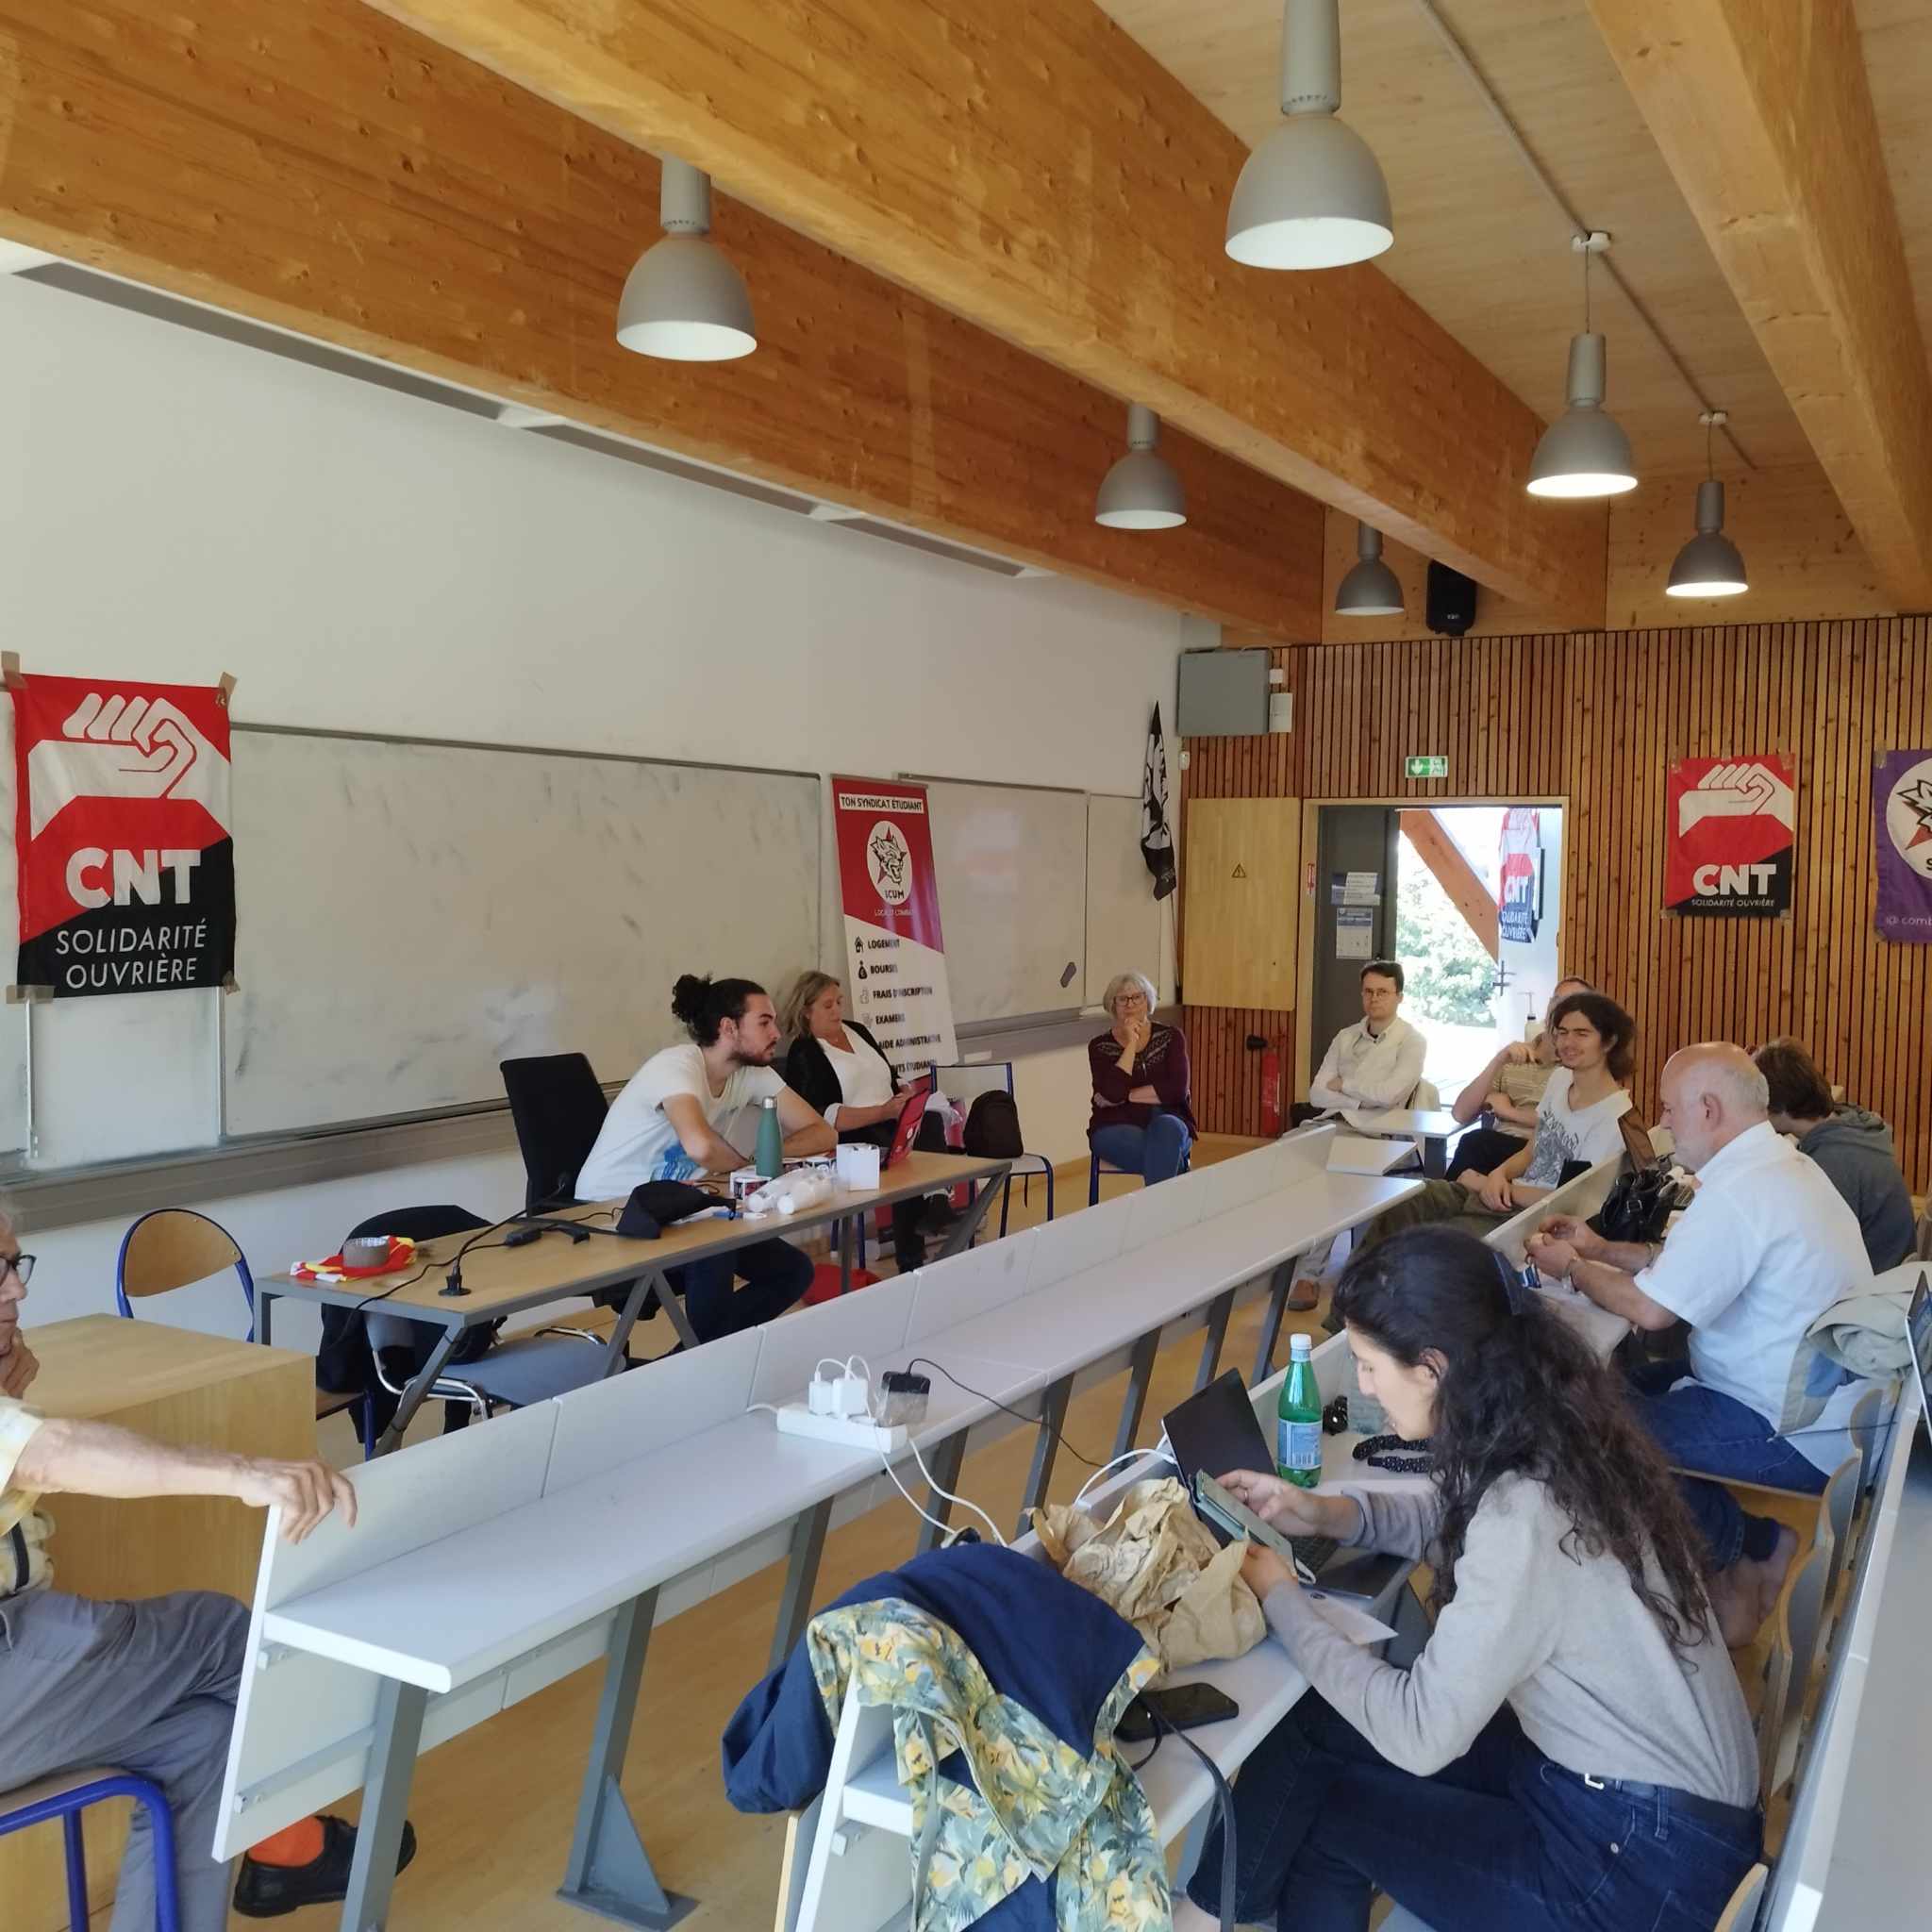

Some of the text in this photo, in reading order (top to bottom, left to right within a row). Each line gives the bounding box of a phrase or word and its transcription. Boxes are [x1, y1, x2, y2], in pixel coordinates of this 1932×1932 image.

[841, 797, 857, 807] TON
[857, 798, 890, 808] SYNDICAT
[65, 847, 201, 908] CNT
[1692, 863, 1777, 896] CNT
[1691, 897, 1774, 907] SOLIDARITÉ OUVRIÈRE
[56, 918, 207, 956] SOLIDARITÉ
[66, 953, 197, 989] OUVRIÈRE
[873, 989, 892, 999] FRAIS
